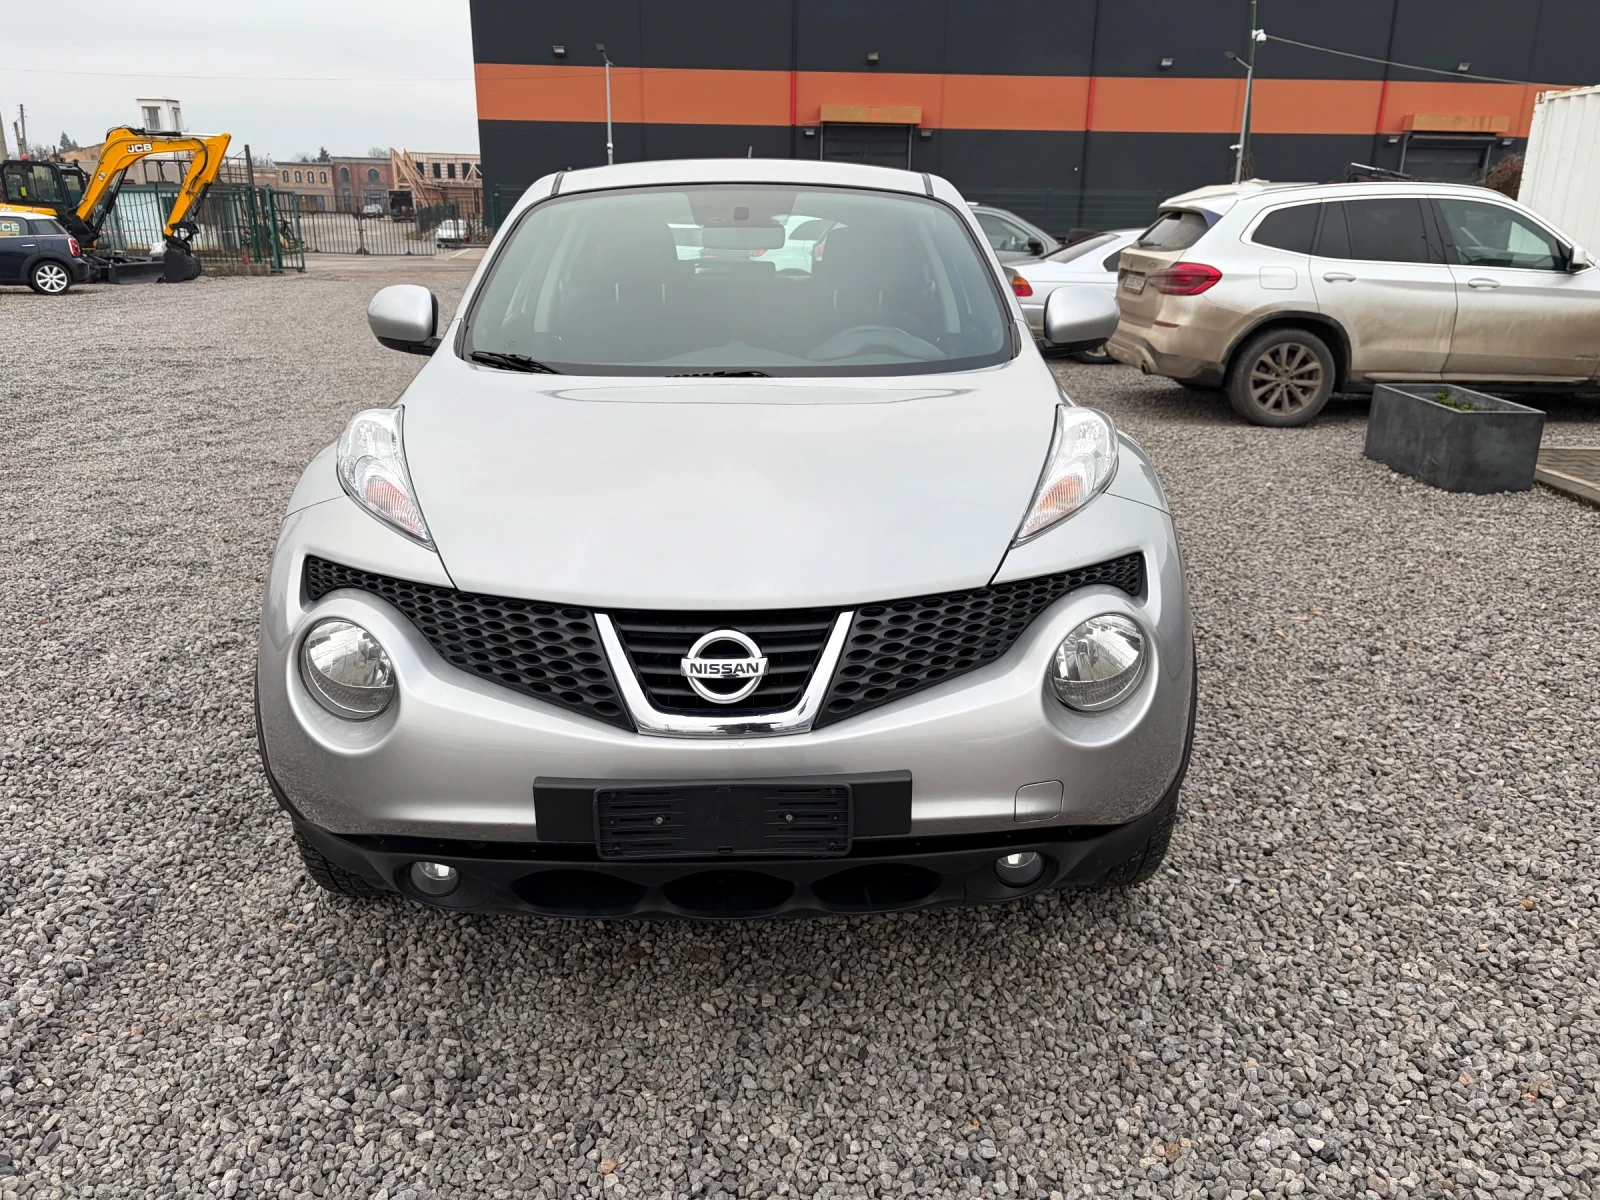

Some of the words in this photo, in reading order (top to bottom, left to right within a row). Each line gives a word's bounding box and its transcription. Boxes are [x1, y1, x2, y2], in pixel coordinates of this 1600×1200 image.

[127, 143, 152, 153] JCB
[0, 223, 20, 232] CB
[689, 662, 759, 675] NISSAN
